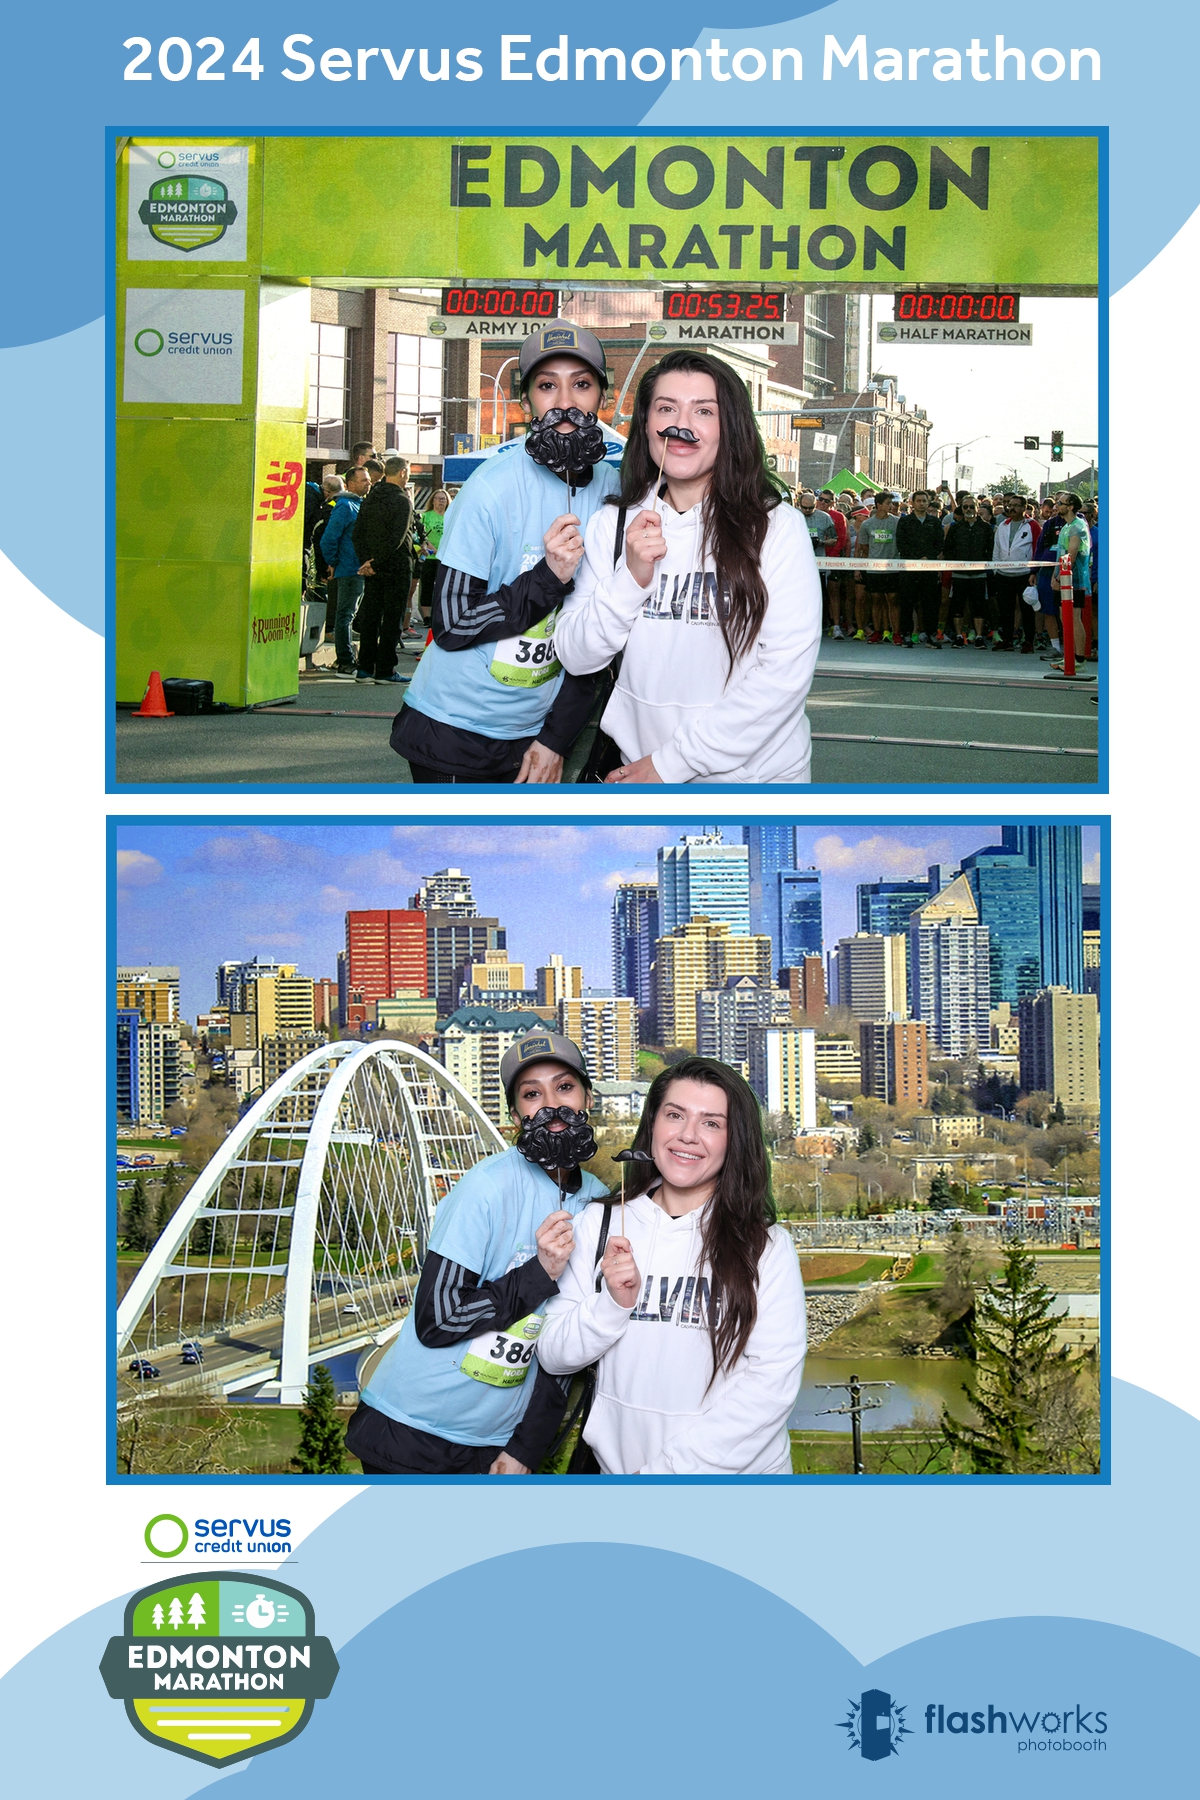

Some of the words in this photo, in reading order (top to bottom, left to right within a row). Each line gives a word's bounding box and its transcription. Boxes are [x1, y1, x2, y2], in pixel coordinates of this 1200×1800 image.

[178, 152, 220, 161] servus
[451, 144, 990, 211] EDMONTON
[149, 203, 227, 214] EDMONTON
[160, 214, 216, 222] MARATHON
[524, 222, 906, 271] MARATHON
[466, 321, 518, 336] ARMY
[678, 325, 785, 340] MARATHON
[900, 328, 939, 340] HALF
[942, 328, 1031, 341] MARATHON
[168, 332, 233, 345] servus
[168, 345, 200, 354] credit
[203, 347, 233, 355] union
[258, 613, 290, 640] Running
